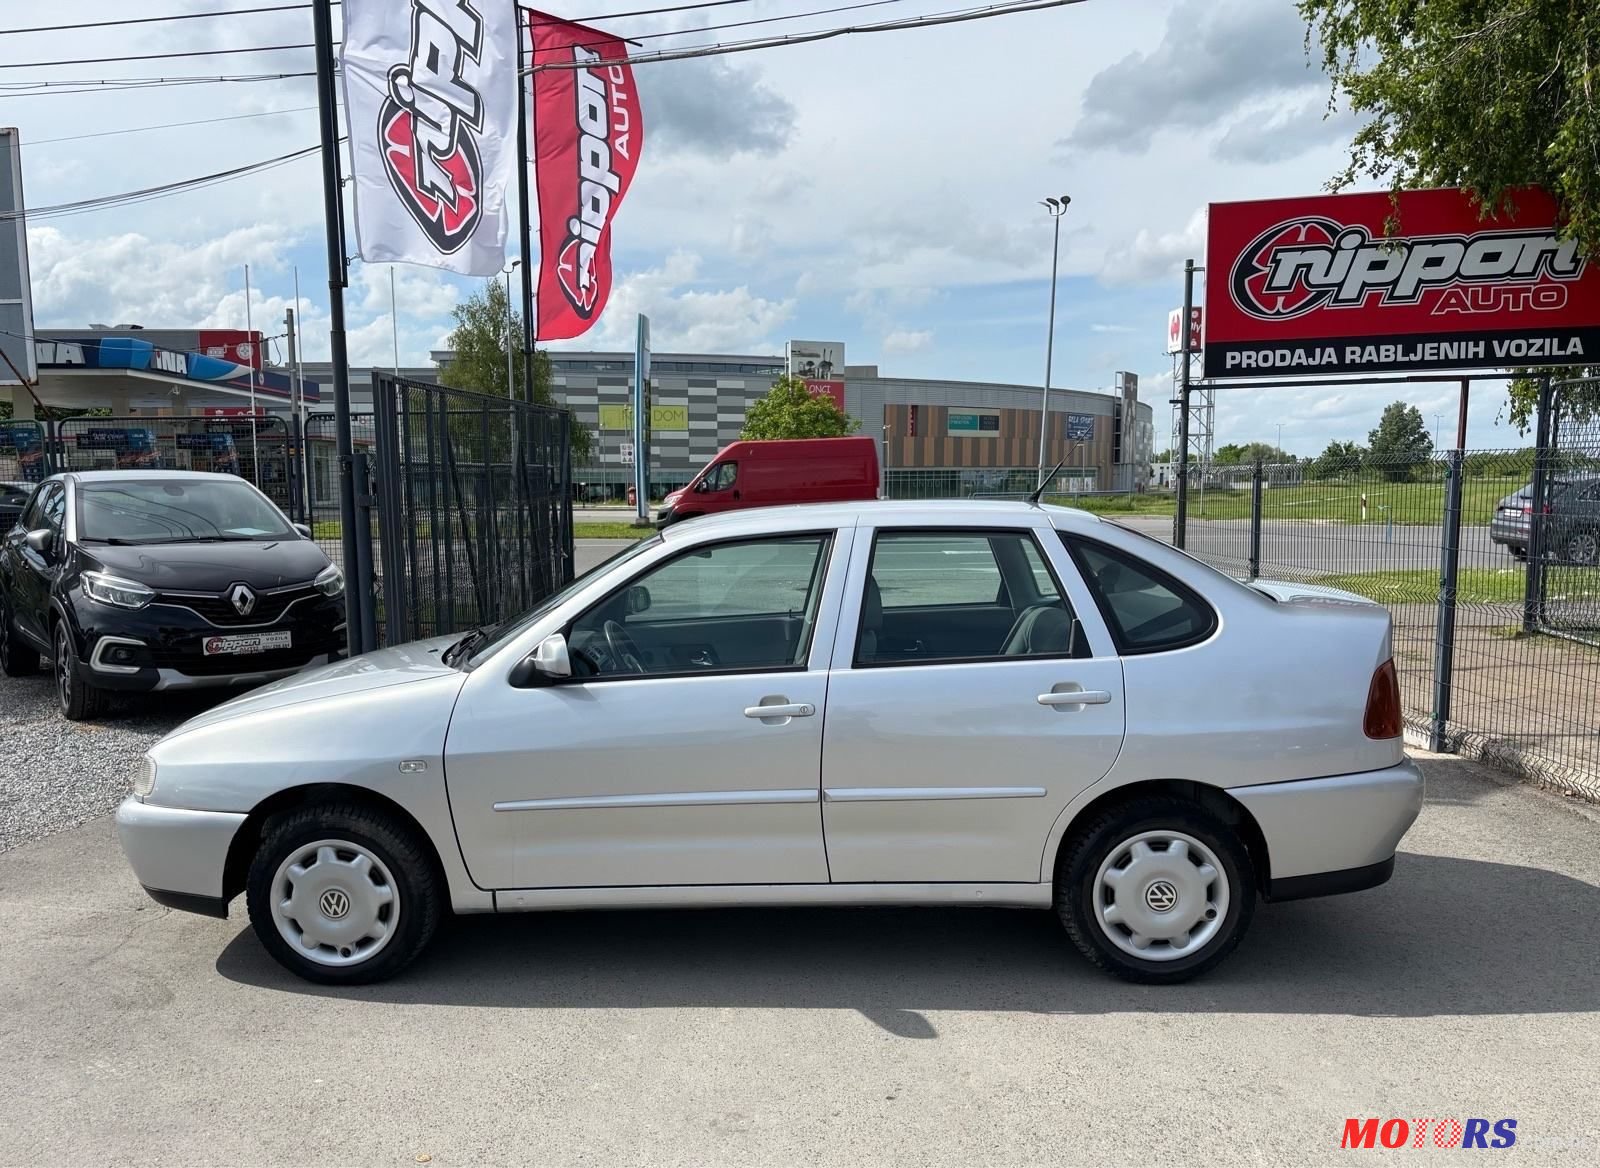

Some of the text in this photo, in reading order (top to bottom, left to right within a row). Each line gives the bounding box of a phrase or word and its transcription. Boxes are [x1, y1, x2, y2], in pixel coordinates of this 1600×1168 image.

[608, 65, 630, 161] AUTO
[568, 43, 621, 290] nippon
[1267, 229, 1582, 304] nippon
[1431, 284, 1568, 315] AUTO
[37, 342, 86, 365] NA
[1225, 337, 1584, 369] PRODAJA RABLJENIH VOZILA
[212, 637, 261, 651] nippon
